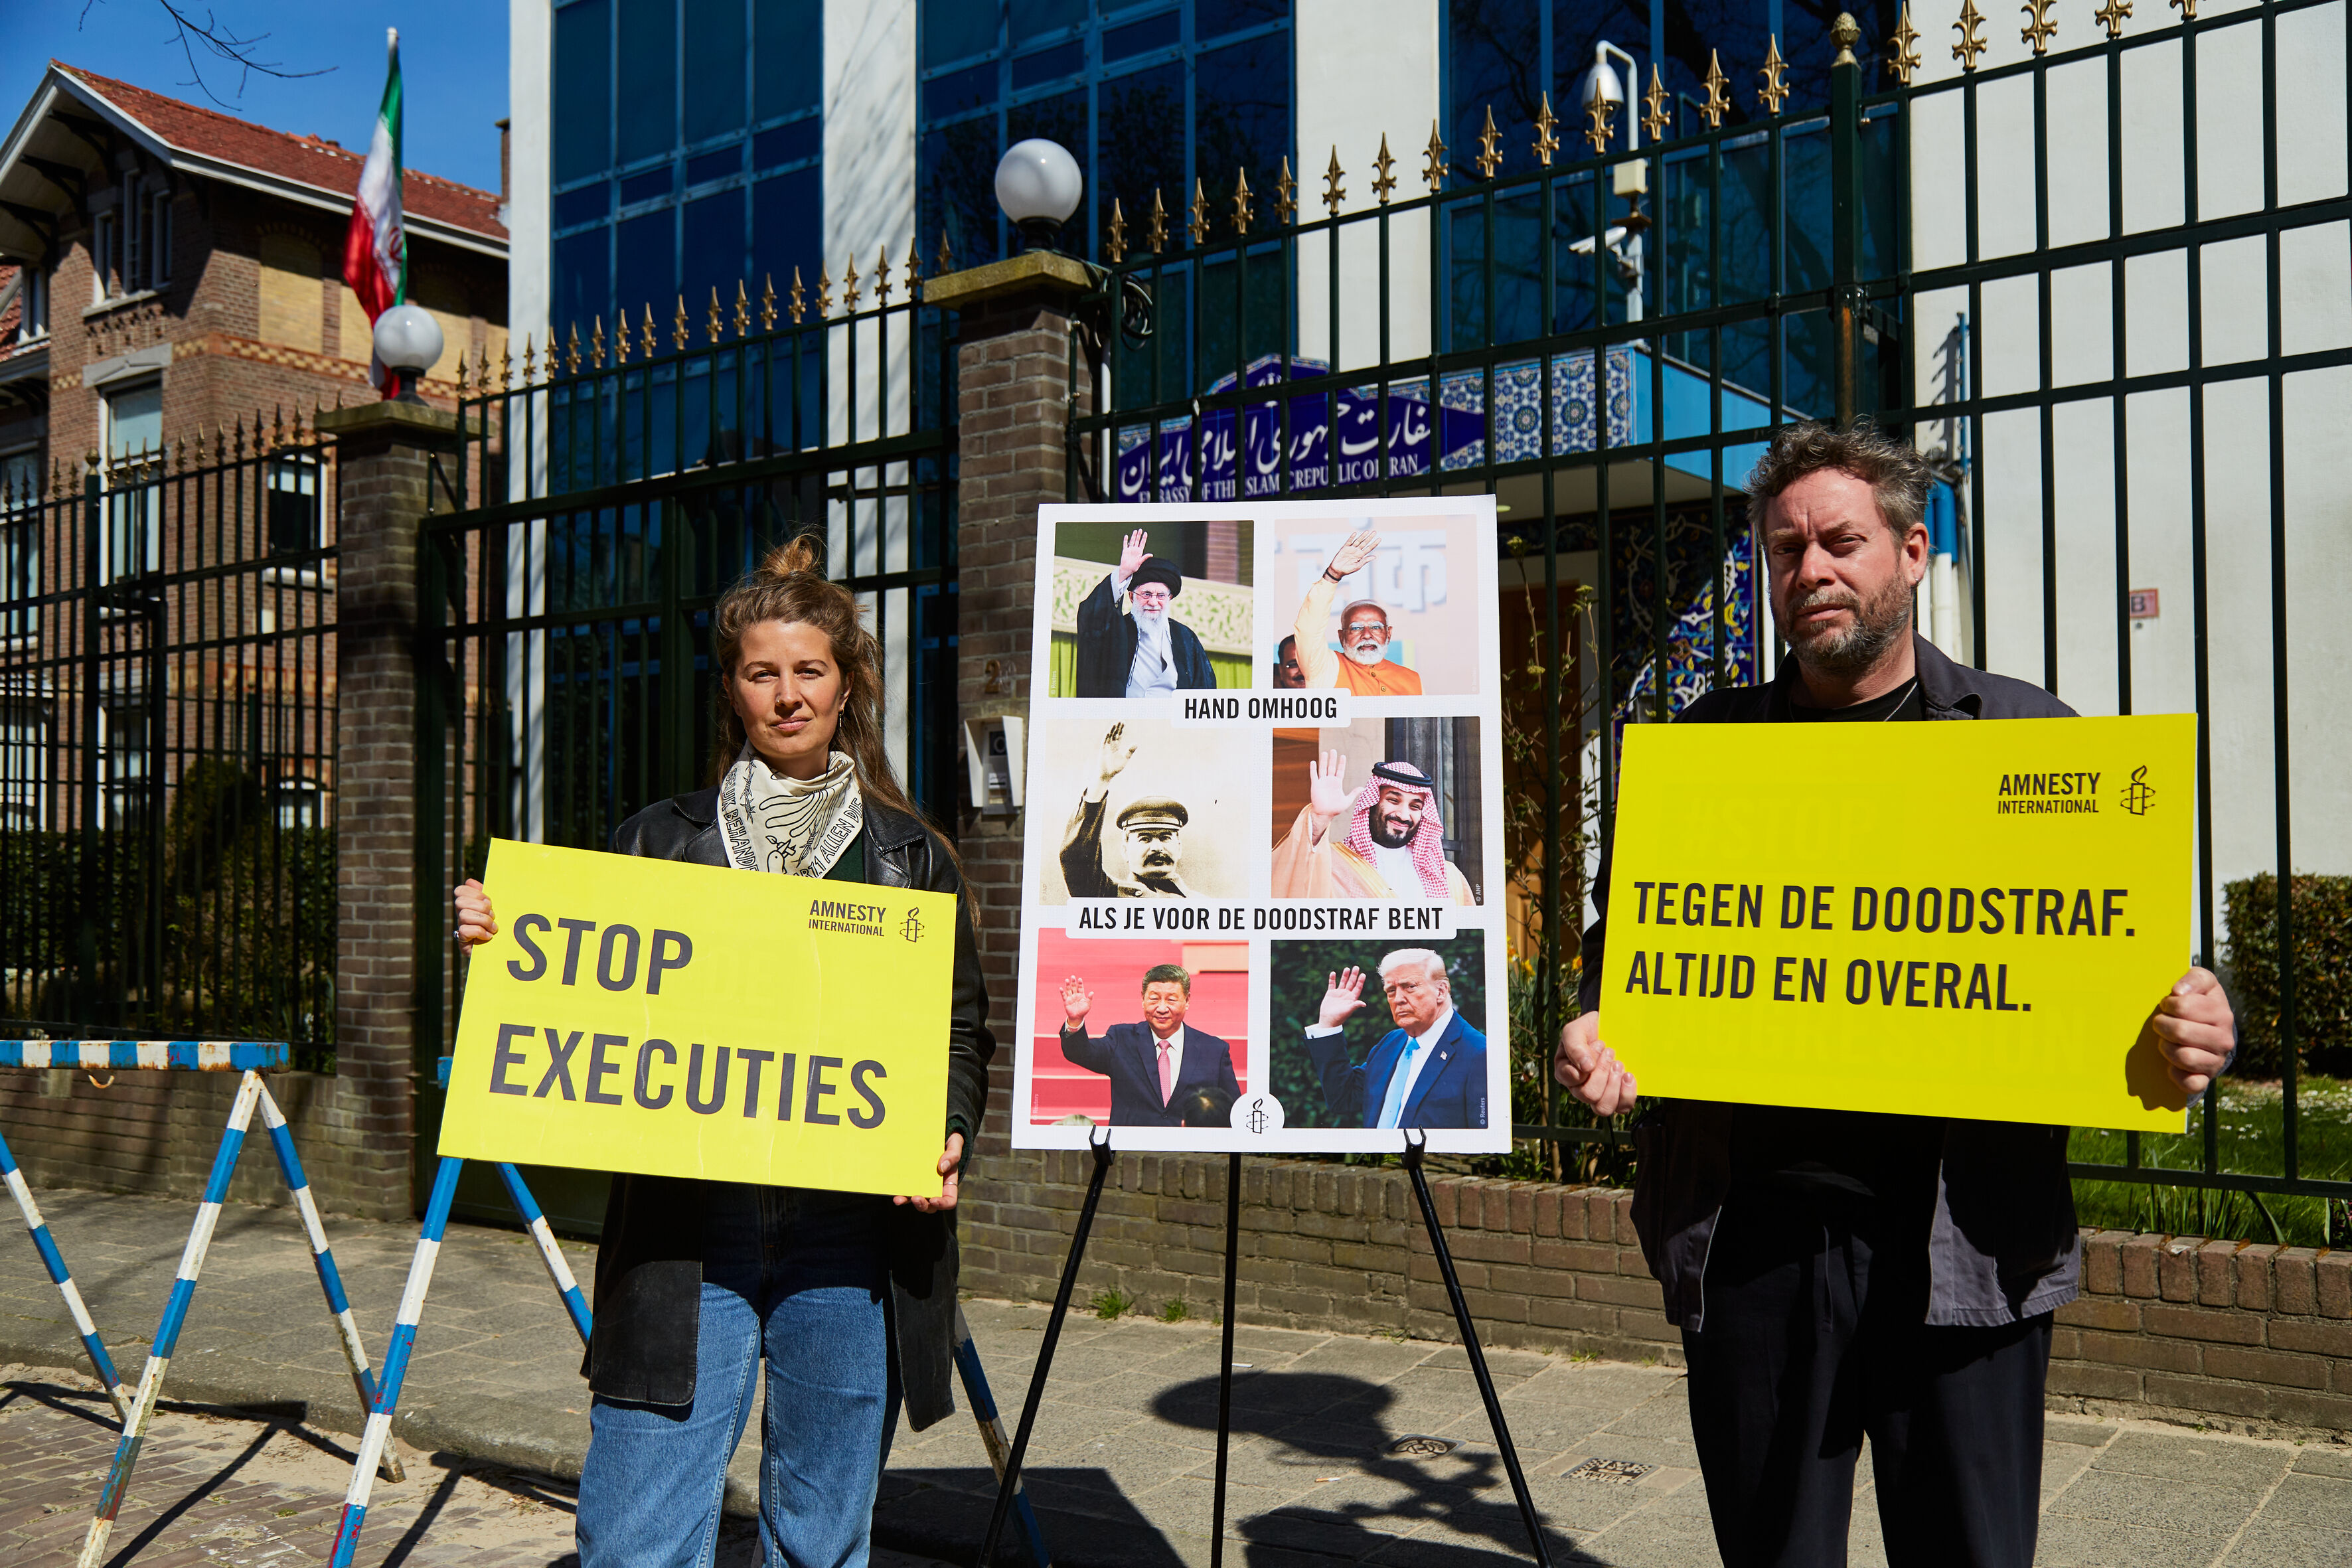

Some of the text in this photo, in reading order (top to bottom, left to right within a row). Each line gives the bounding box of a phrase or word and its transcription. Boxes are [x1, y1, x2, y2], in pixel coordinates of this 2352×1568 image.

[1295, 461, 1361, 489] REPULIC
[1389, 453, 1418, 477] RAN
[1186, 698, 1336, 719] HAND OMHOOG
[1998, 772, 2102, 796] AMNESTY
[1997, 799, 2100, 815] INTERNATIONAL
[819, 818, 856, 864] ALLEN
[809, 900, 887, 923] AMNESTY
[1079, 907, 1443, 930] ALS JE VOOR DE DOODSTRAF BENT
[1634, 882, 2135, 937] TEGEN DE DOODSTRAF.
[808, 919, 885, 937] INTERNATIONAL
[507, 913, 693, 996] STOP
[1625, 951, 2031, 1012] ALTIJD EN OVERAL.
[489, 1023, 888, 1129] EXECUTIES
